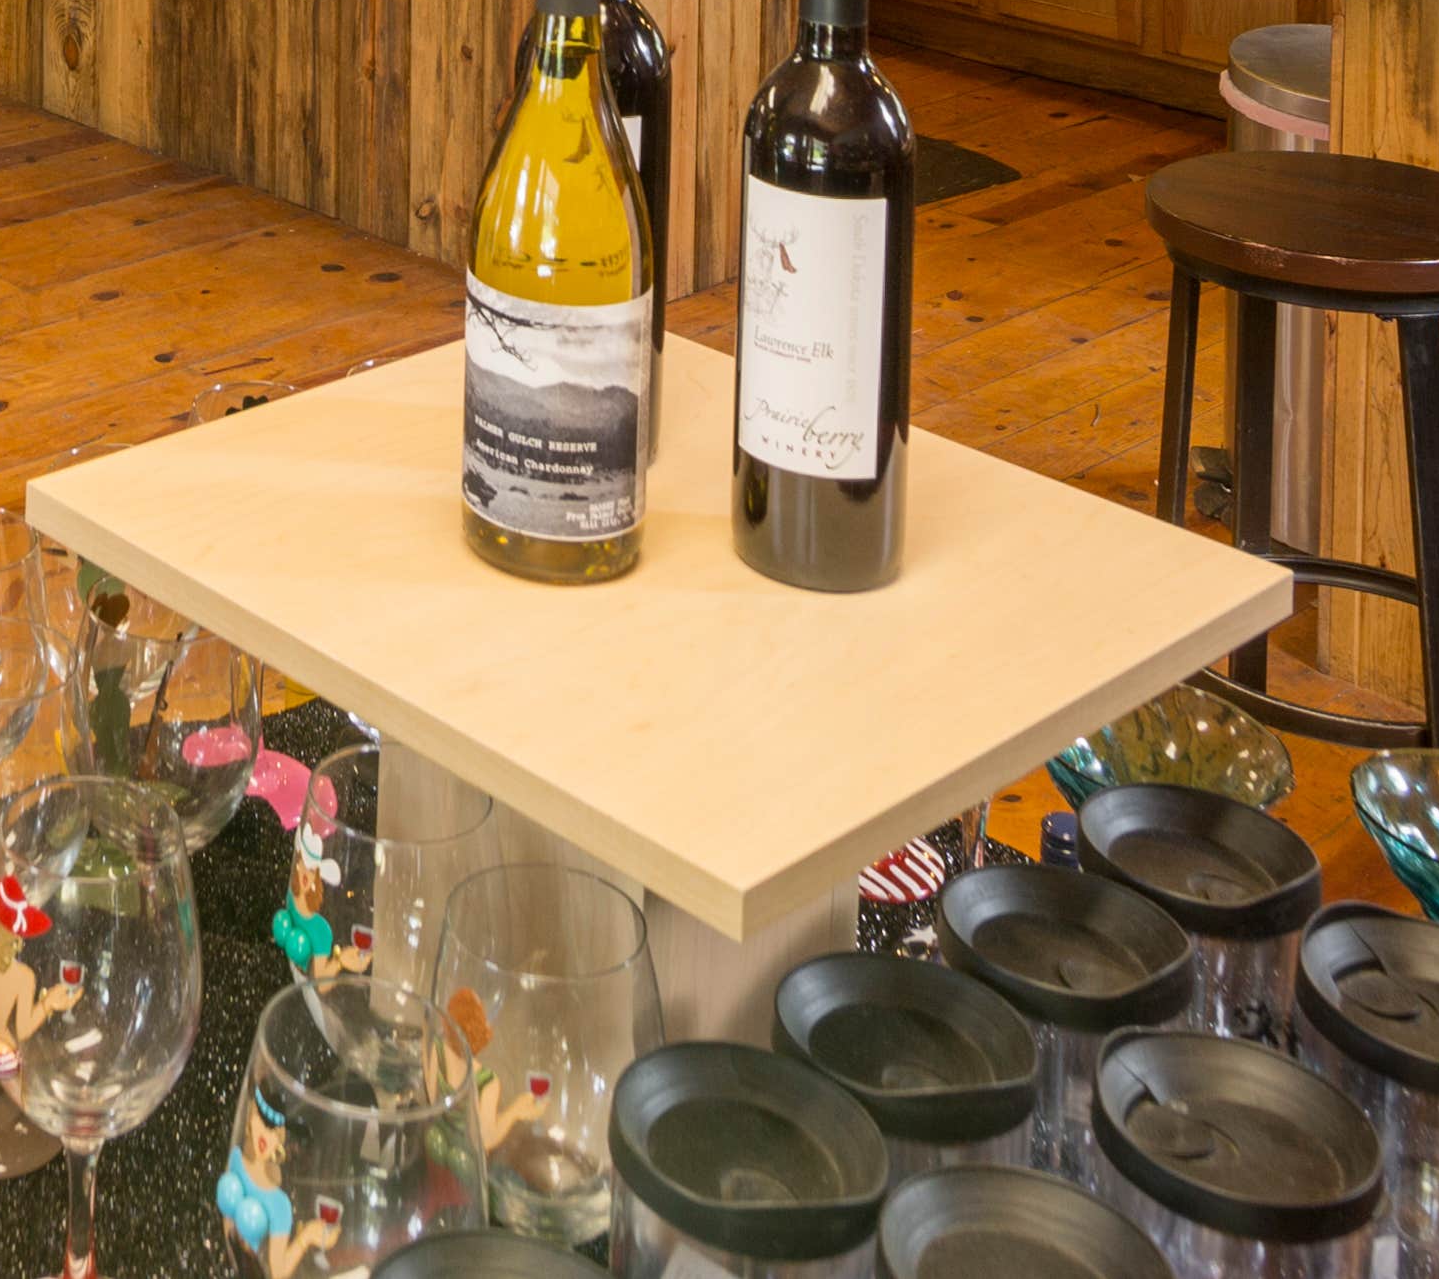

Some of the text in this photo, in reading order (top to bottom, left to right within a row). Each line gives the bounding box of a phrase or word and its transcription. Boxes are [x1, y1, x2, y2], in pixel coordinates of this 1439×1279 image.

[754, 324, 809, 356] Lawrence
[811, 341, 835, 359] Elk
[474, 414, 597, 452] PALMER GULCH RESERVE
[761, 435, 836, 460] WINERY
[476, 438, 594, 476] American Chardonnay
